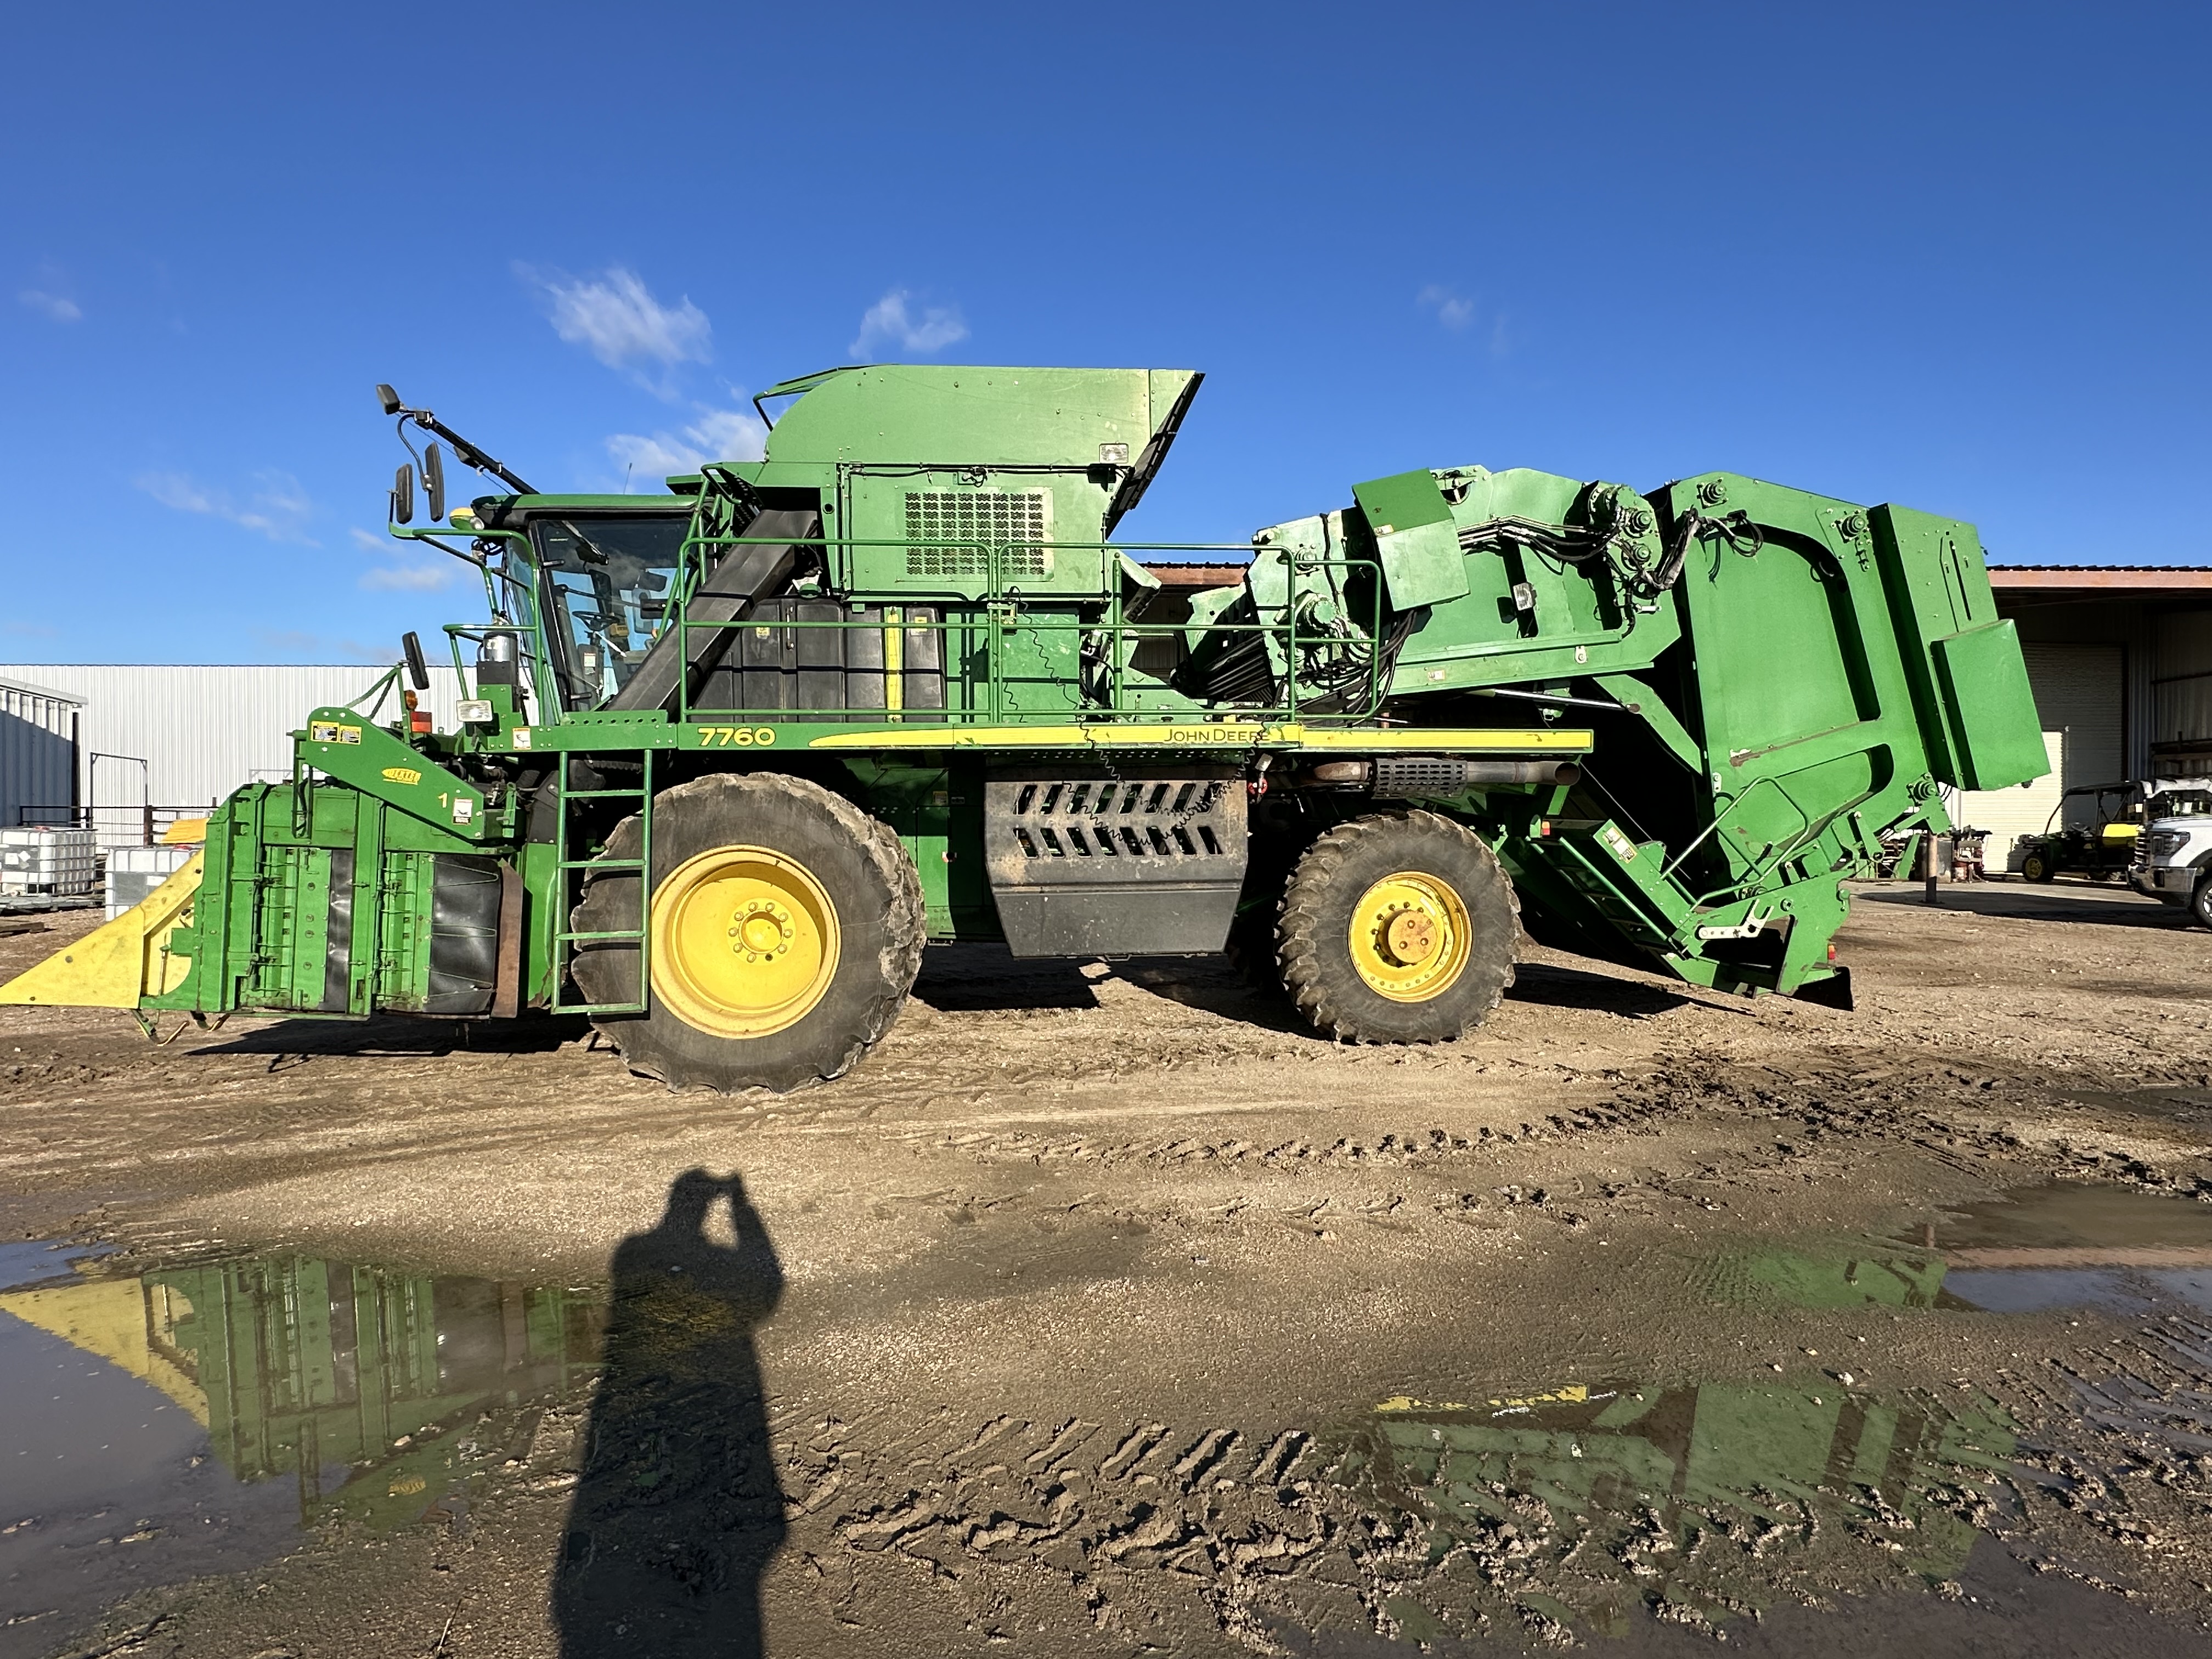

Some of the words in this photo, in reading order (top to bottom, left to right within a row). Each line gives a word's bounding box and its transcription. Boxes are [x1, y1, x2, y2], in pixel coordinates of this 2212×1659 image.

[698, 727, 776, 746] 7760
[1164, 729, 1209, 741] JOHN
[438, 793, 447, 808] 1
